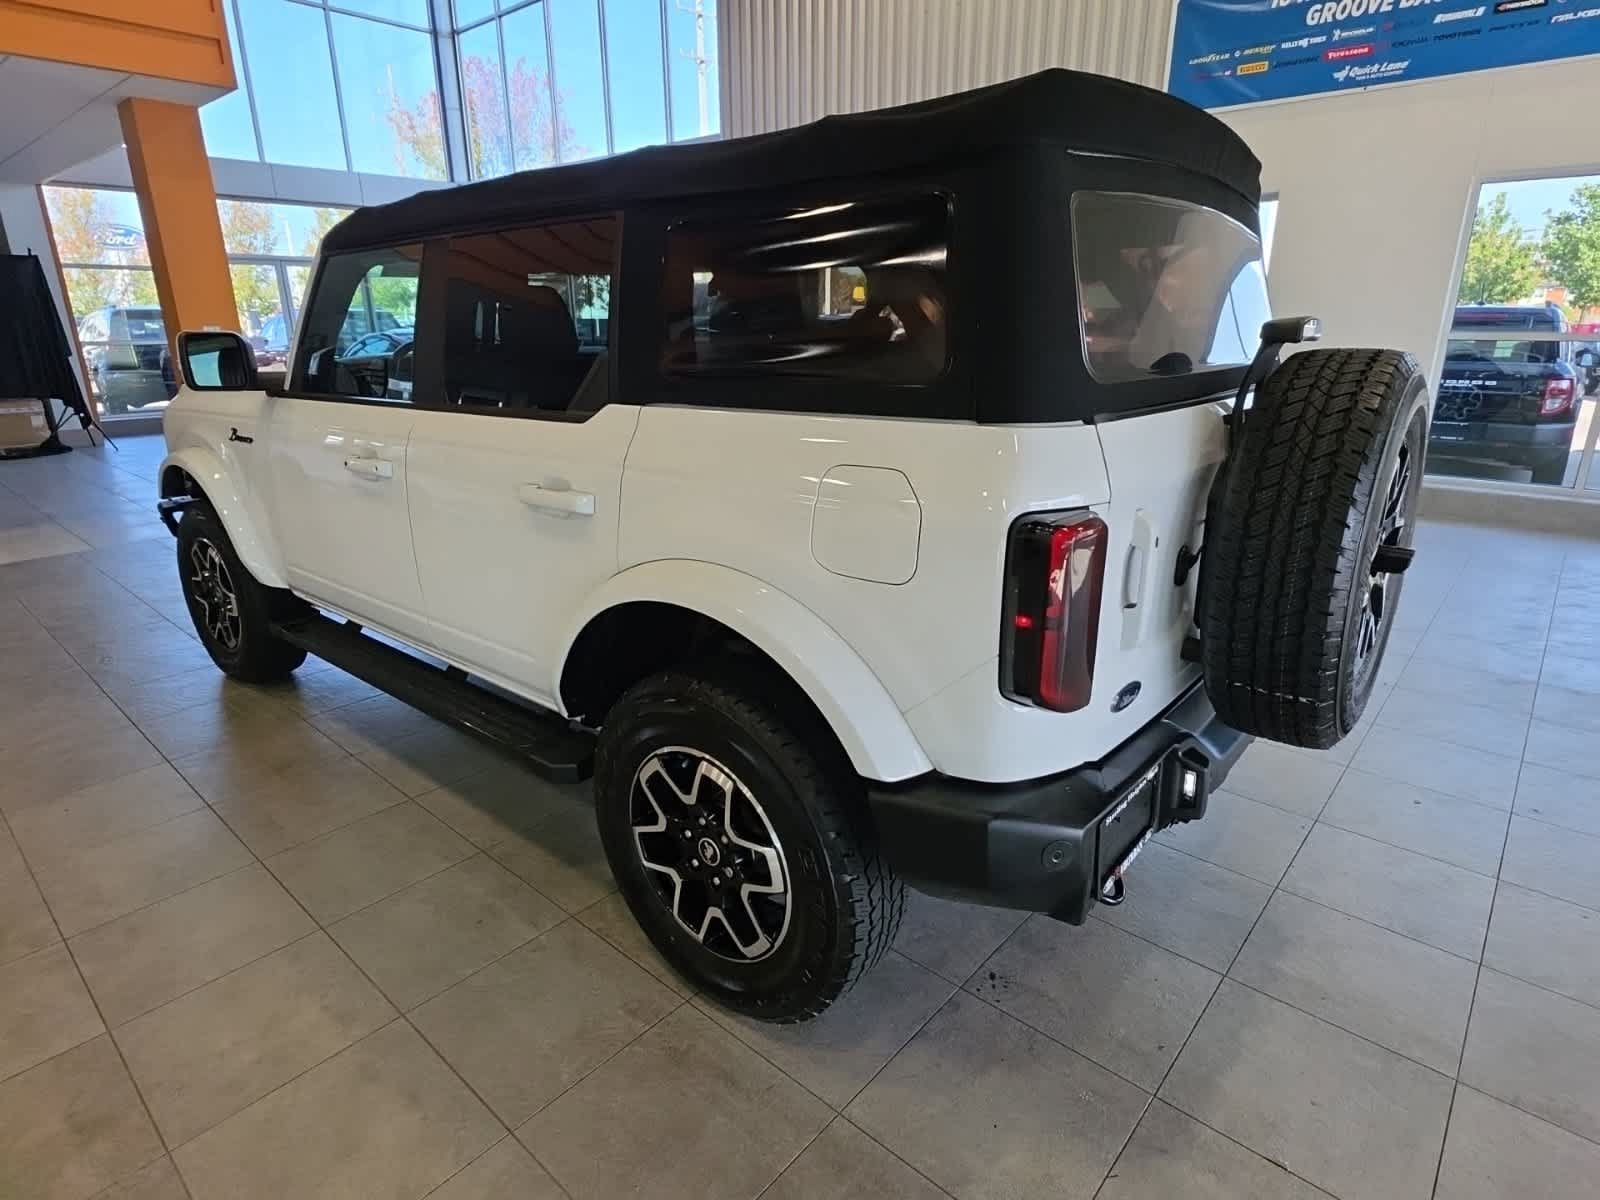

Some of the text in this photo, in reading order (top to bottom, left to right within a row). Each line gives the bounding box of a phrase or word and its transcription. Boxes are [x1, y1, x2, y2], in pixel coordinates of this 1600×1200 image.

[1306, 0, 1393, 25] GROOVE
[1349, 62, 1380, 77] Quick
[1380, 60, 1411, 72] Lane
